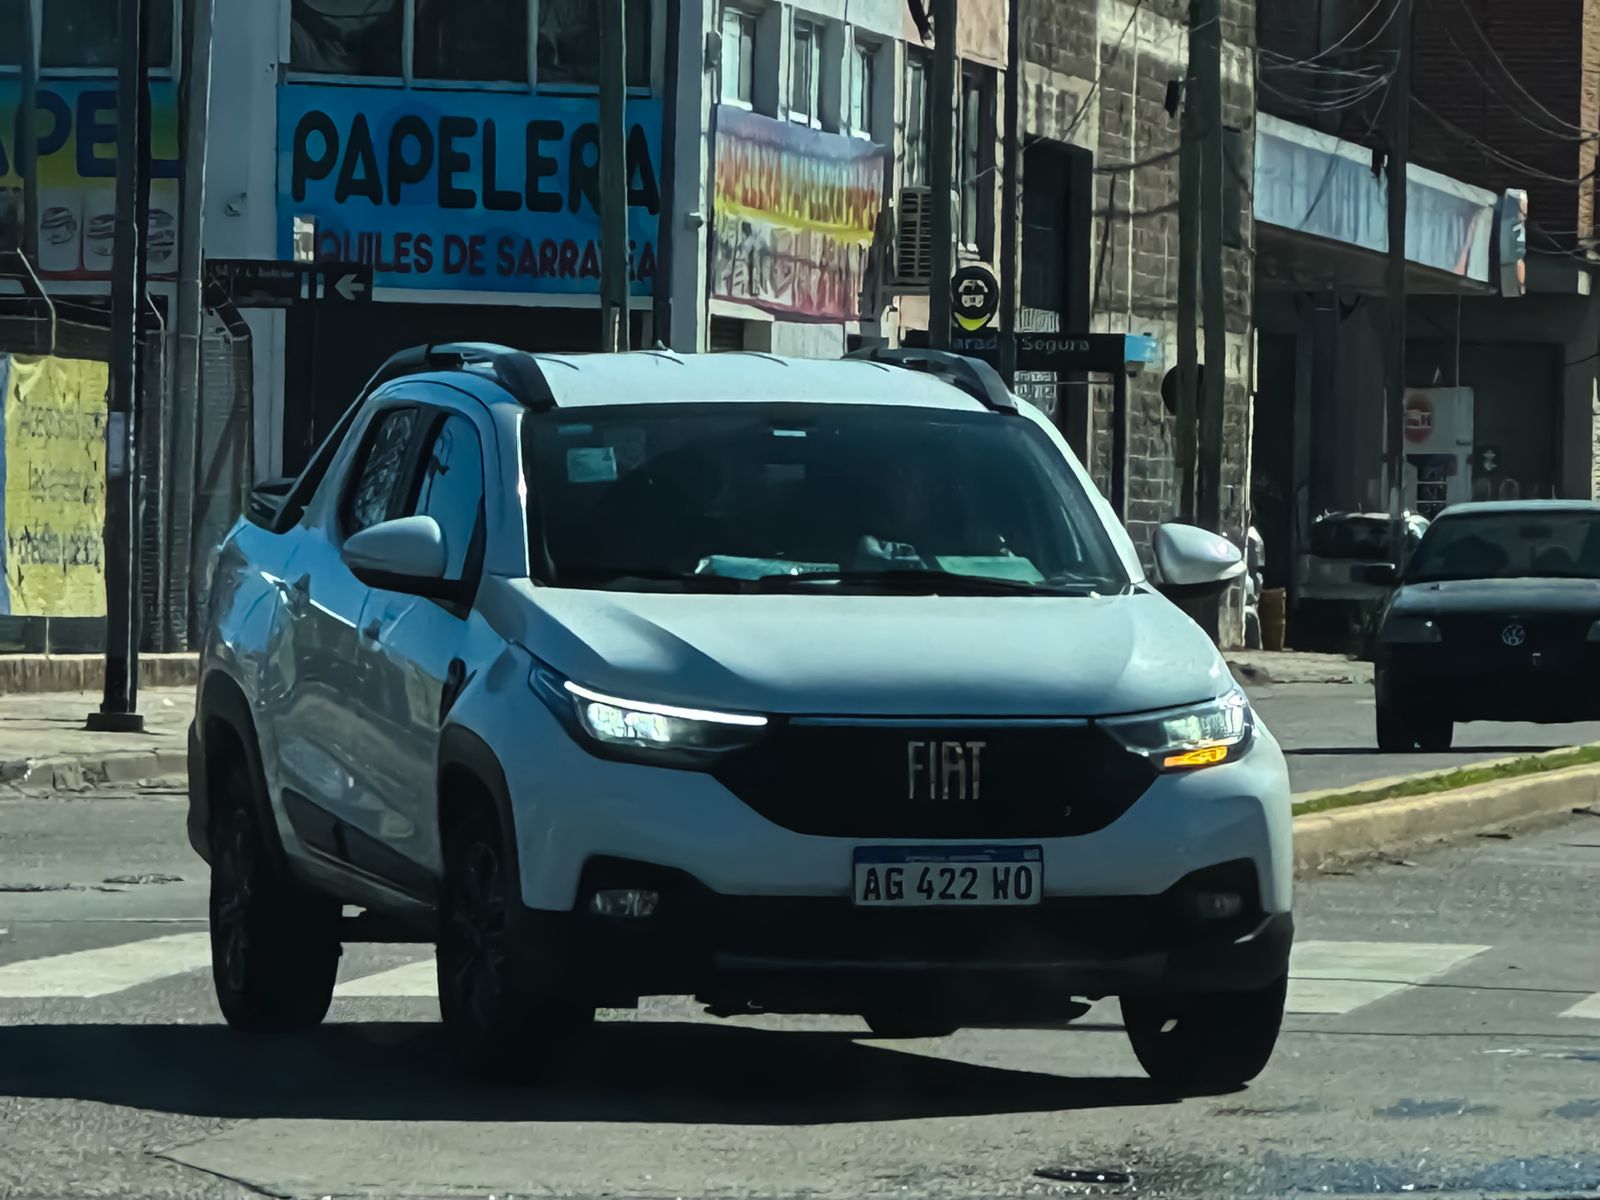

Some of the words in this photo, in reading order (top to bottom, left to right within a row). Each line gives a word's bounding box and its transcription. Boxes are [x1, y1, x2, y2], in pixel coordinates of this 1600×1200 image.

[291, 109, 661, 214] PAPELERA
[443, 234, 486, 276] DE
[497, 236, 657, 282] SARRAA
[1020, 335, 1090, 354] Segura
[908, 741, 986, 799] FIAT
[864, 867, 904, 901] AG
[917, 867, 979, 900] 422
